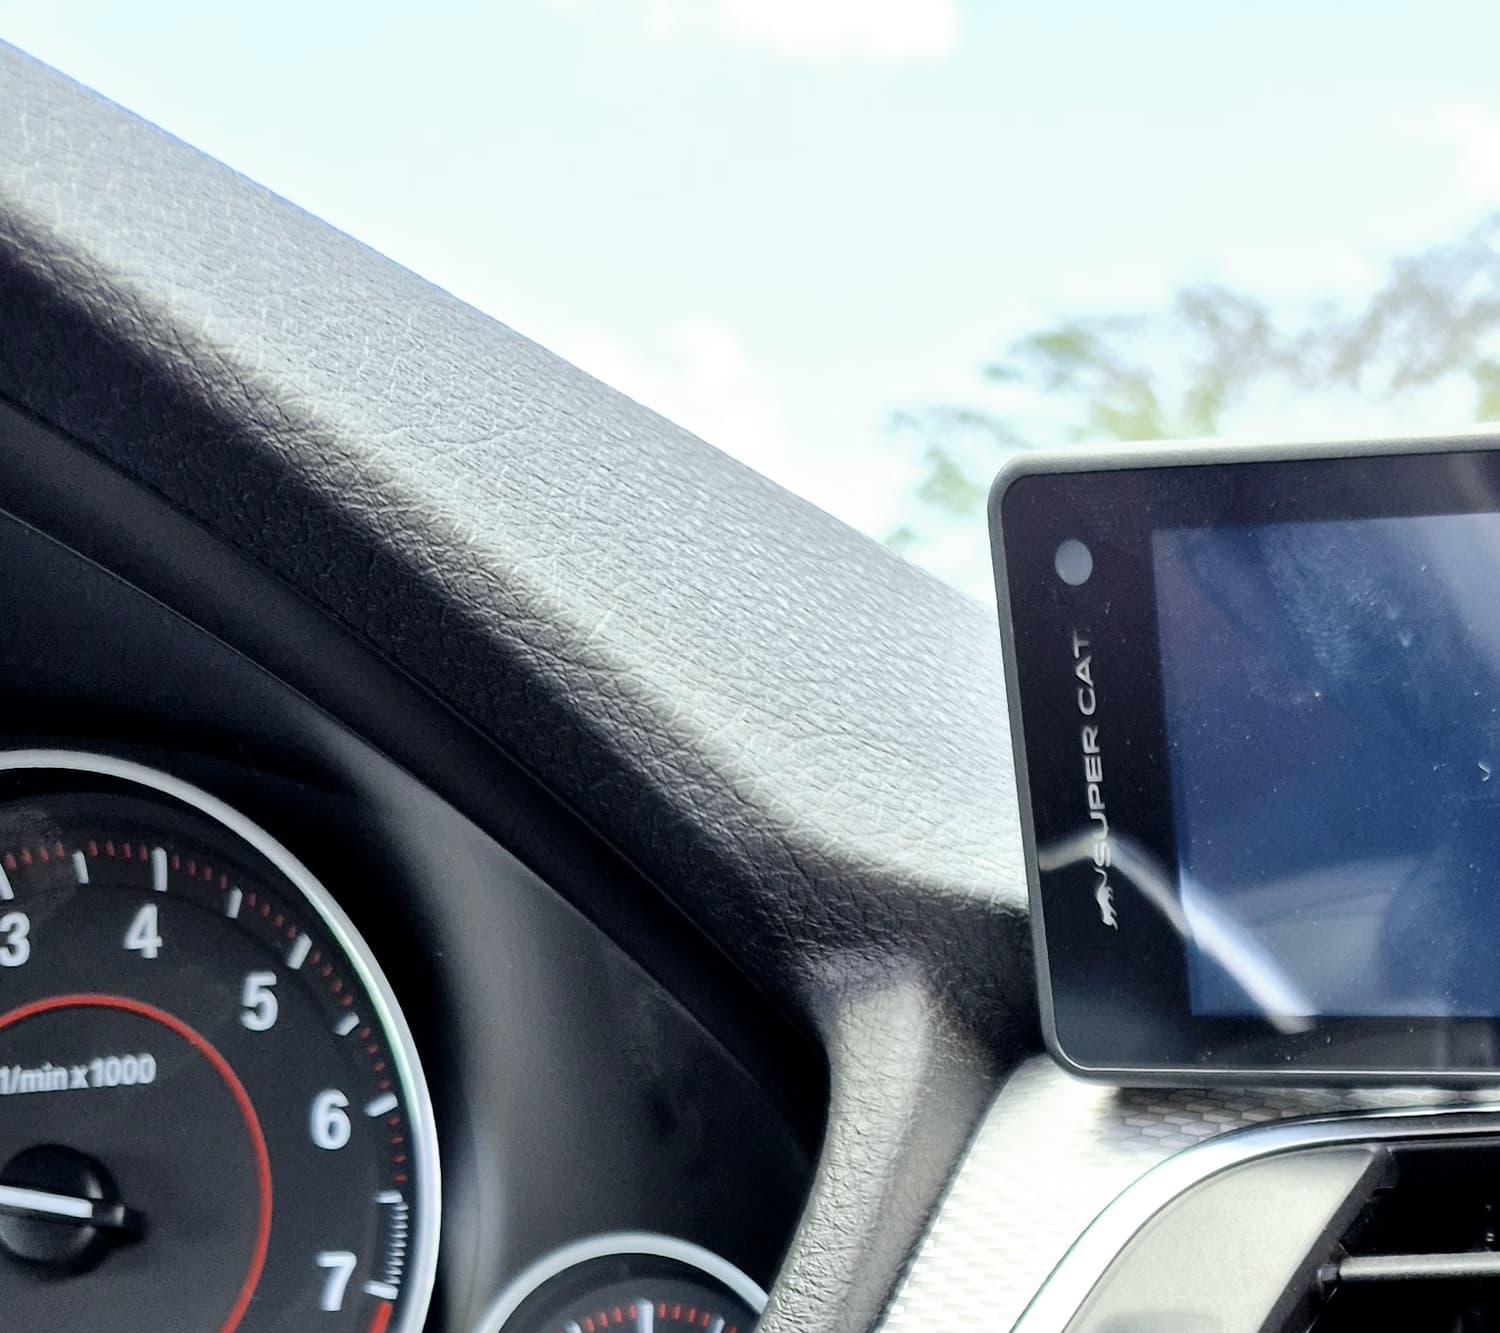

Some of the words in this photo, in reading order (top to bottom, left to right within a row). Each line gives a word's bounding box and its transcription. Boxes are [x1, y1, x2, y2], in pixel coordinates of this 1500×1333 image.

[1072, 628, 1097, 716] CAT
[1081, 725, 1111, 868] SUPER
[0, 911, 31, 967] 3
[124, 903, 163, 959] 4
[239, 970, 279, 1032] 5
[311, 1089, 351, 1150] 6
[316, 1251, 357, 1311] 7
